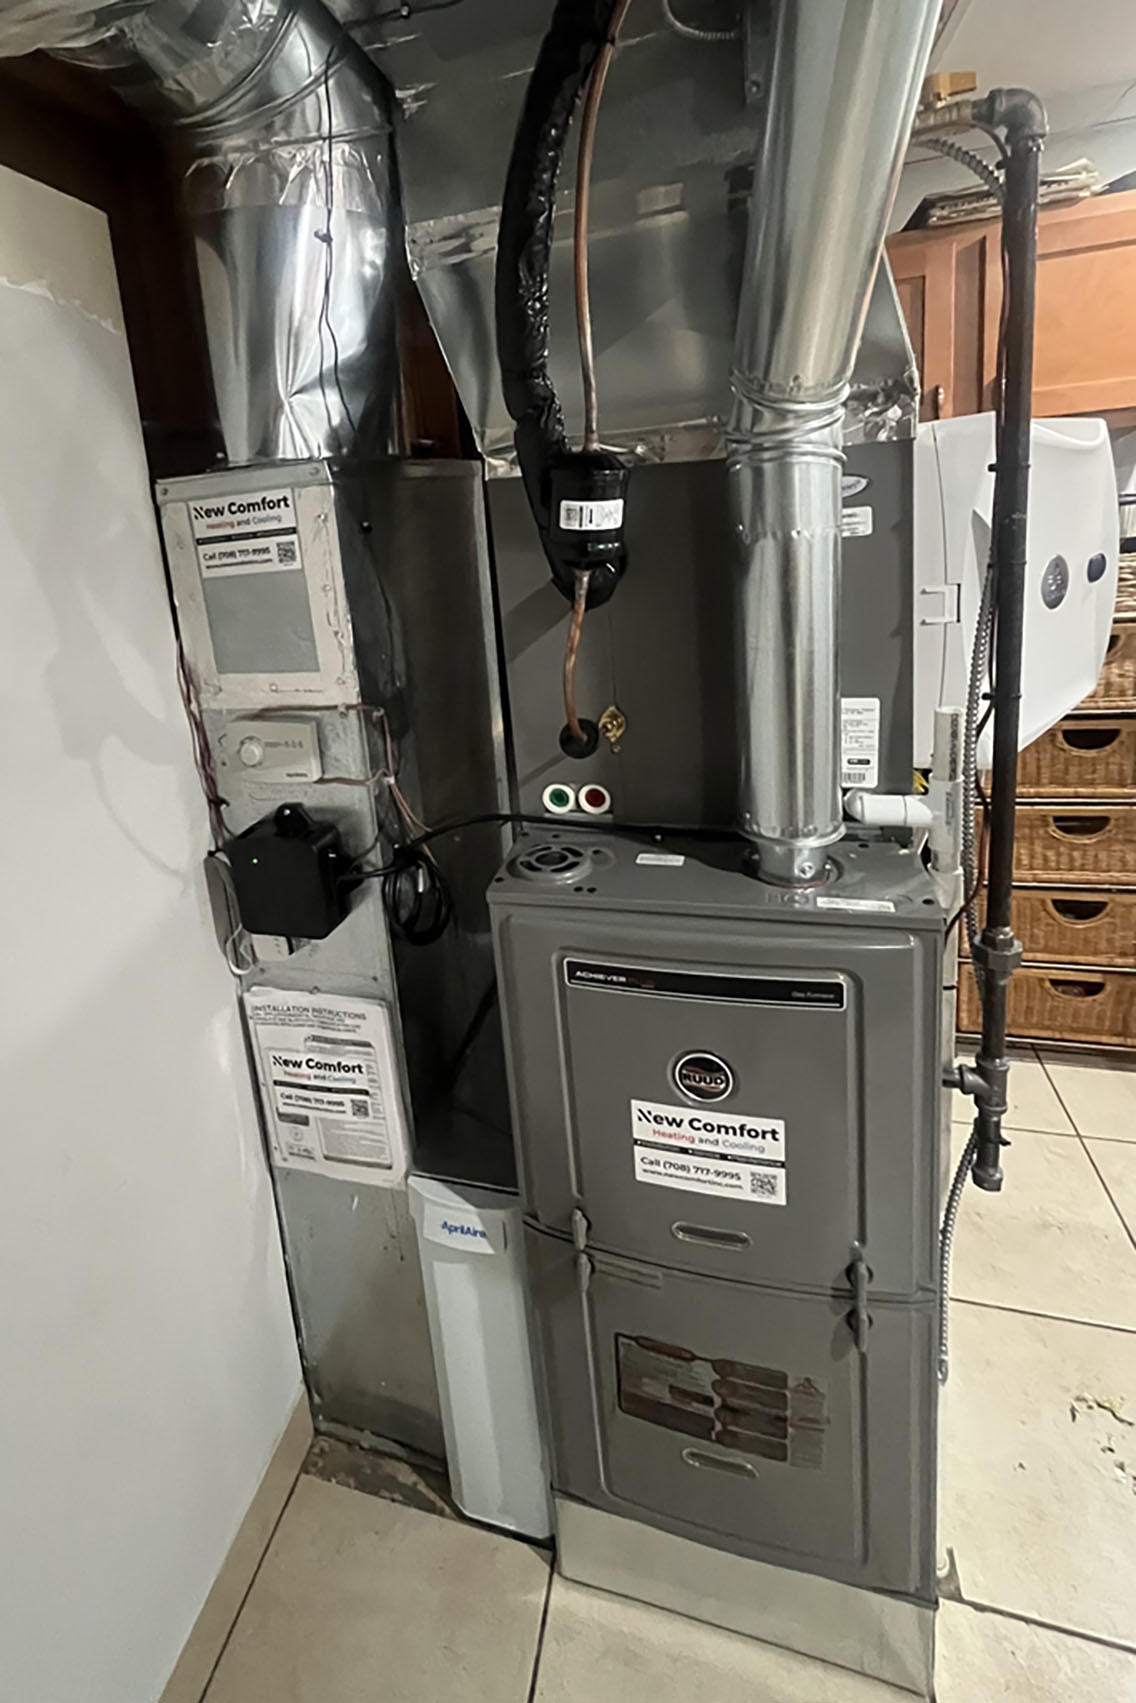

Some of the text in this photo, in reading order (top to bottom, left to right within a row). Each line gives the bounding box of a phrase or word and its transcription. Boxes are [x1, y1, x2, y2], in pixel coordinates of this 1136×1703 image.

[193, 496, 290, 520] New Comfort
[236, 518, 251, 526] and
[252, 1004, 367, 1020] INSTALLATION INSTRUCTIONS
[273, 1056, 364, 1074] New Comfort
[682, 1073, 724, 1086] RUUD
[638, 1108, 780, 1141] New Comfort
[652, 1129, 766, 1153] Heating and Cooling
[640, 1156, 742, 1181] Call (708) 717-9995
